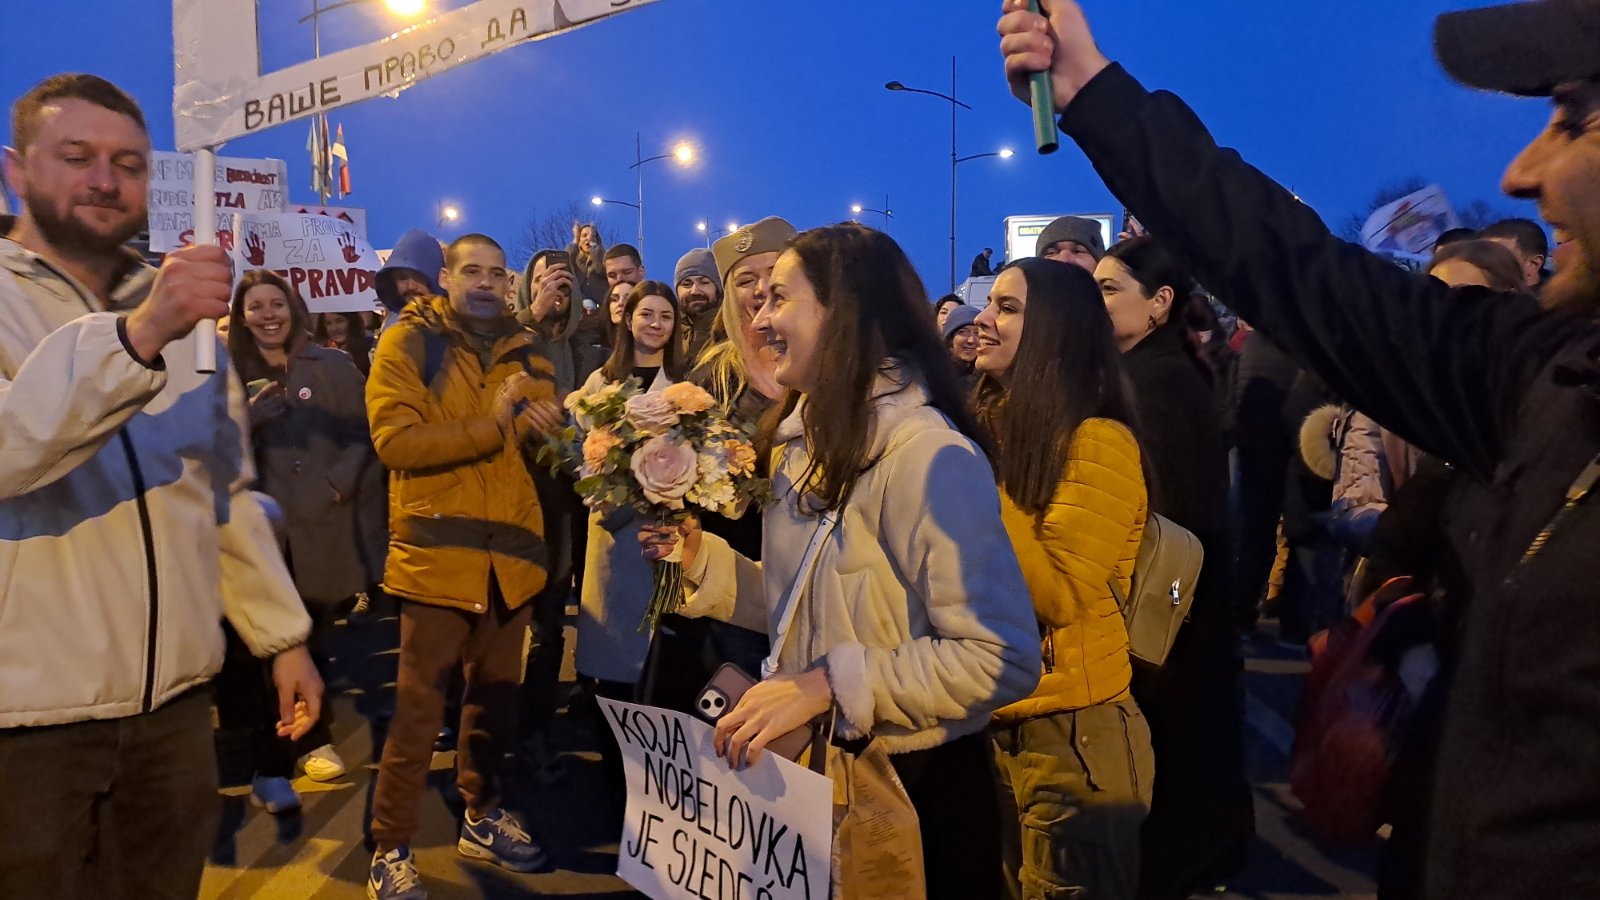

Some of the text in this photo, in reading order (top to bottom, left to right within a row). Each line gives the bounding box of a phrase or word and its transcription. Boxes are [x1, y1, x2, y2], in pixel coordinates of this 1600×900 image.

[245, 7, 528, 130] ВАШЕ ПРАВО ДА
[283, 239, 325, 264] ZA
[608, 704, 692, 769] KOJA
[627, 810, 664, 870] JE
[645, 752, 810, 900] NOBELOVKA
